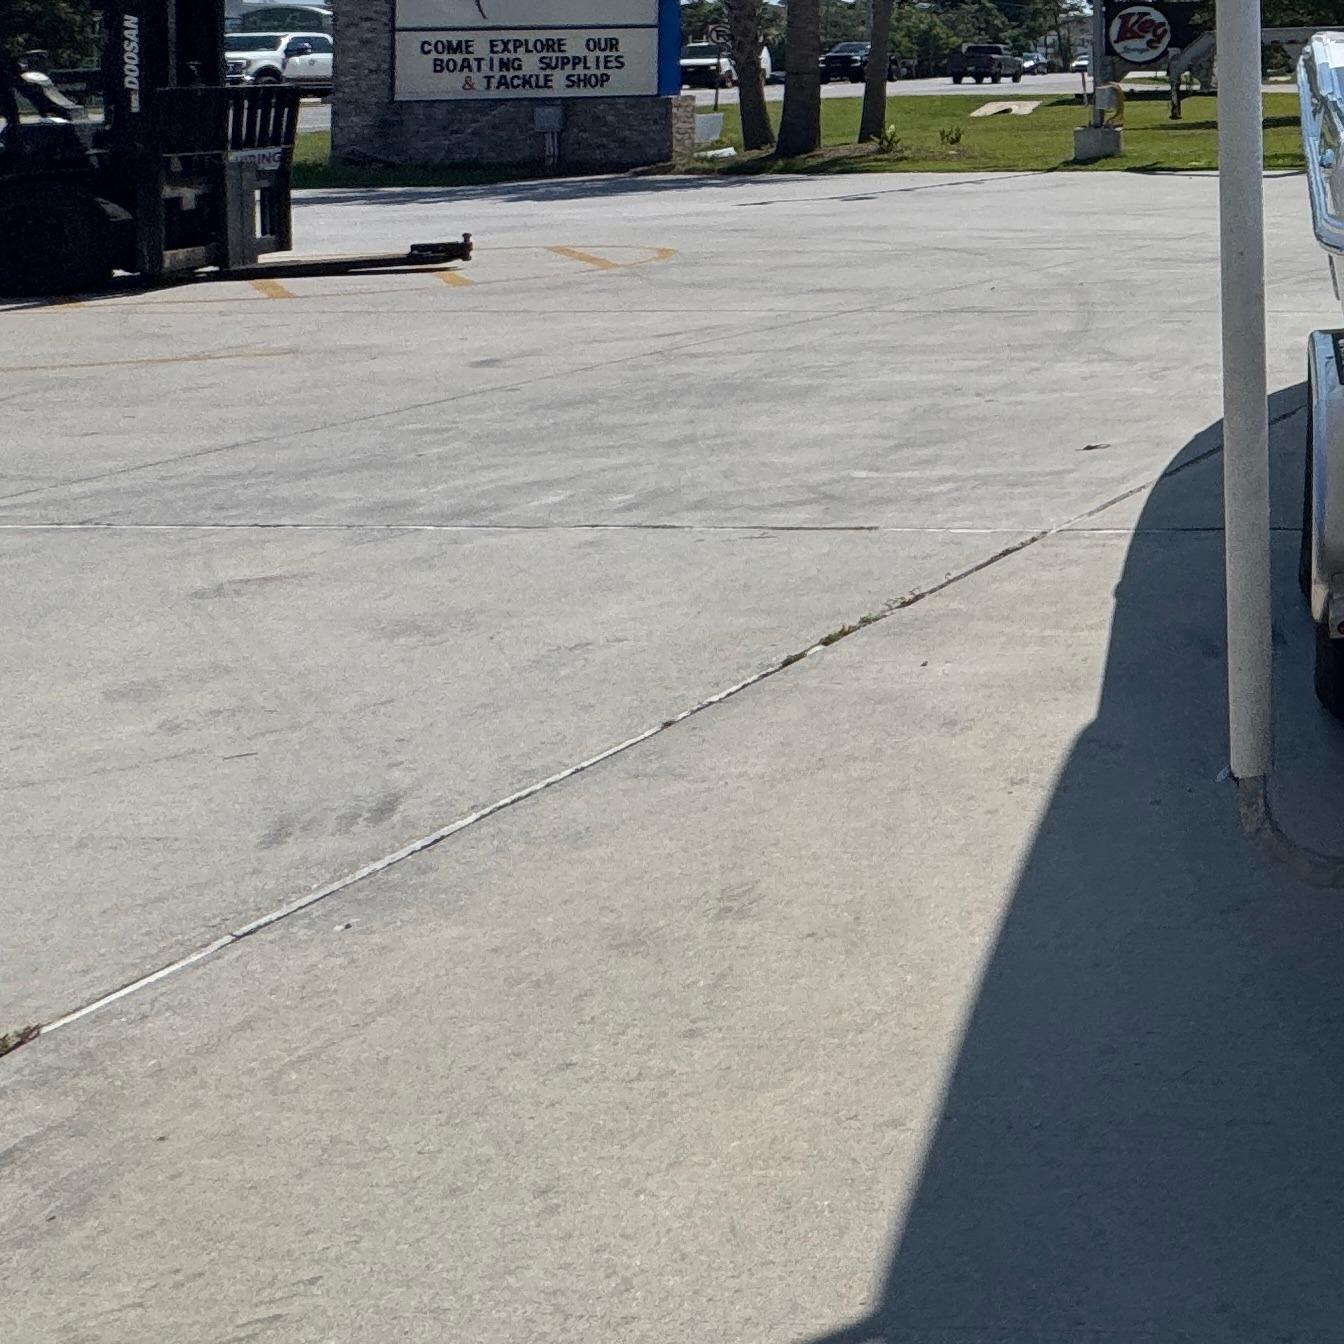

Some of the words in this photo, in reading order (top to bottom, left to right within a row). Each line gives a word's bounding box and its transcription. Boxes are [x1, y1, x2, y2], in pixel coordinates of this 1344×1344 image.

[123, 14, 140, 90] DOOSAN
[420, 39, 475, 55] COME
[489, 38, 567, 54] EXPLORE
[584, 37, 620, 53] OUR
[432, 57, 523, 73] BOATING
[538, 55, 626, 71] SUPPLIES
[462, 77, 476, 91] &
[483, 74, 554, 90] TACKLE
[565, 73, 612, 89] SHOP
